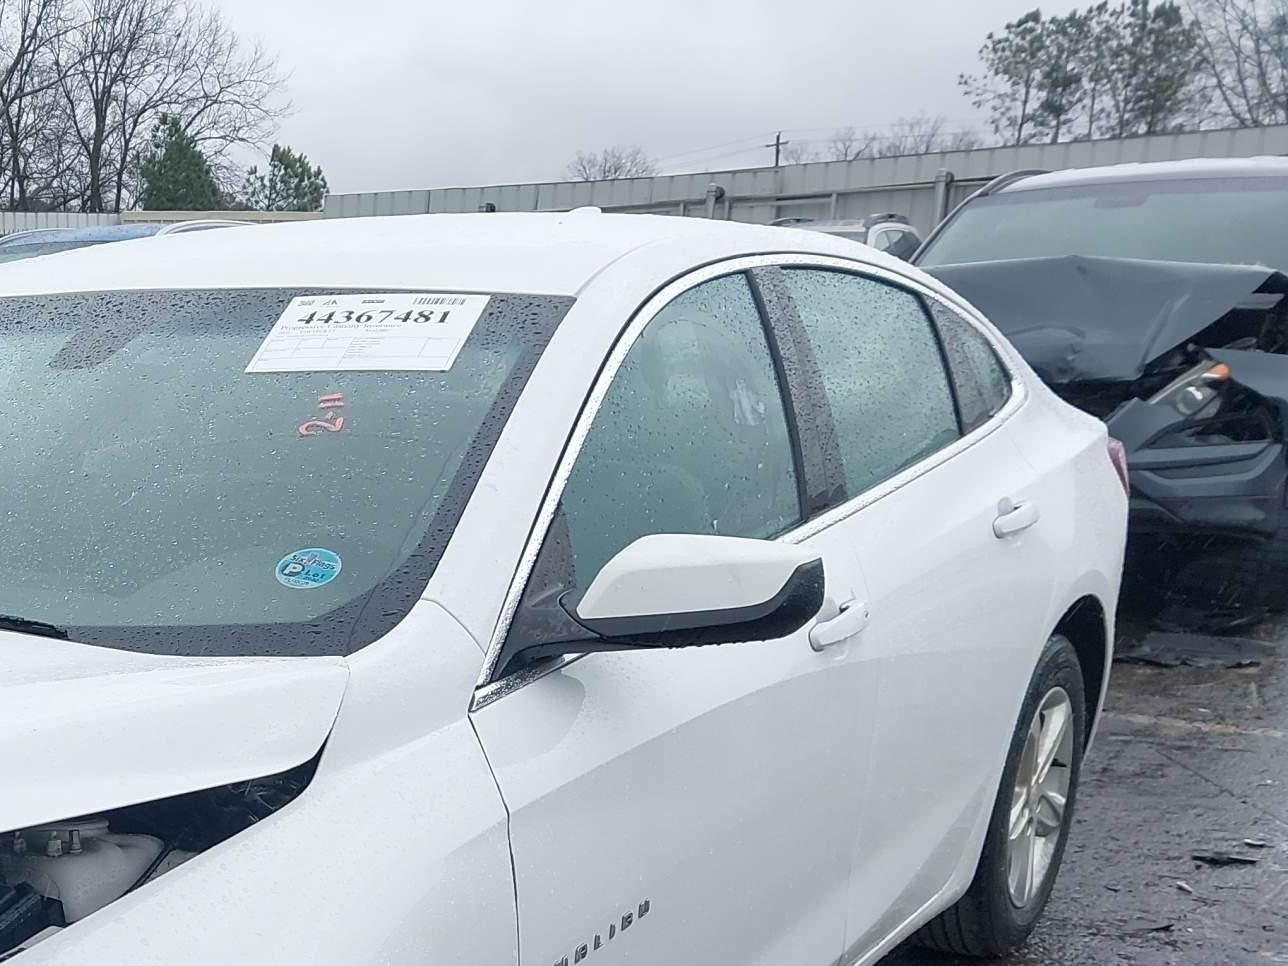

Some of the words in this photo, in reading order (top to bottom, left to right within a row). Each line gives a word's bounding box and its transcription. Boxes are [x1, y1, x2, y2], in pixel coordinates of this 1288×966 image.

[298, 310, 451, 324] 44367481
[289, 554, 306, 563] Six
[311, 558, 337, 570] Flags
